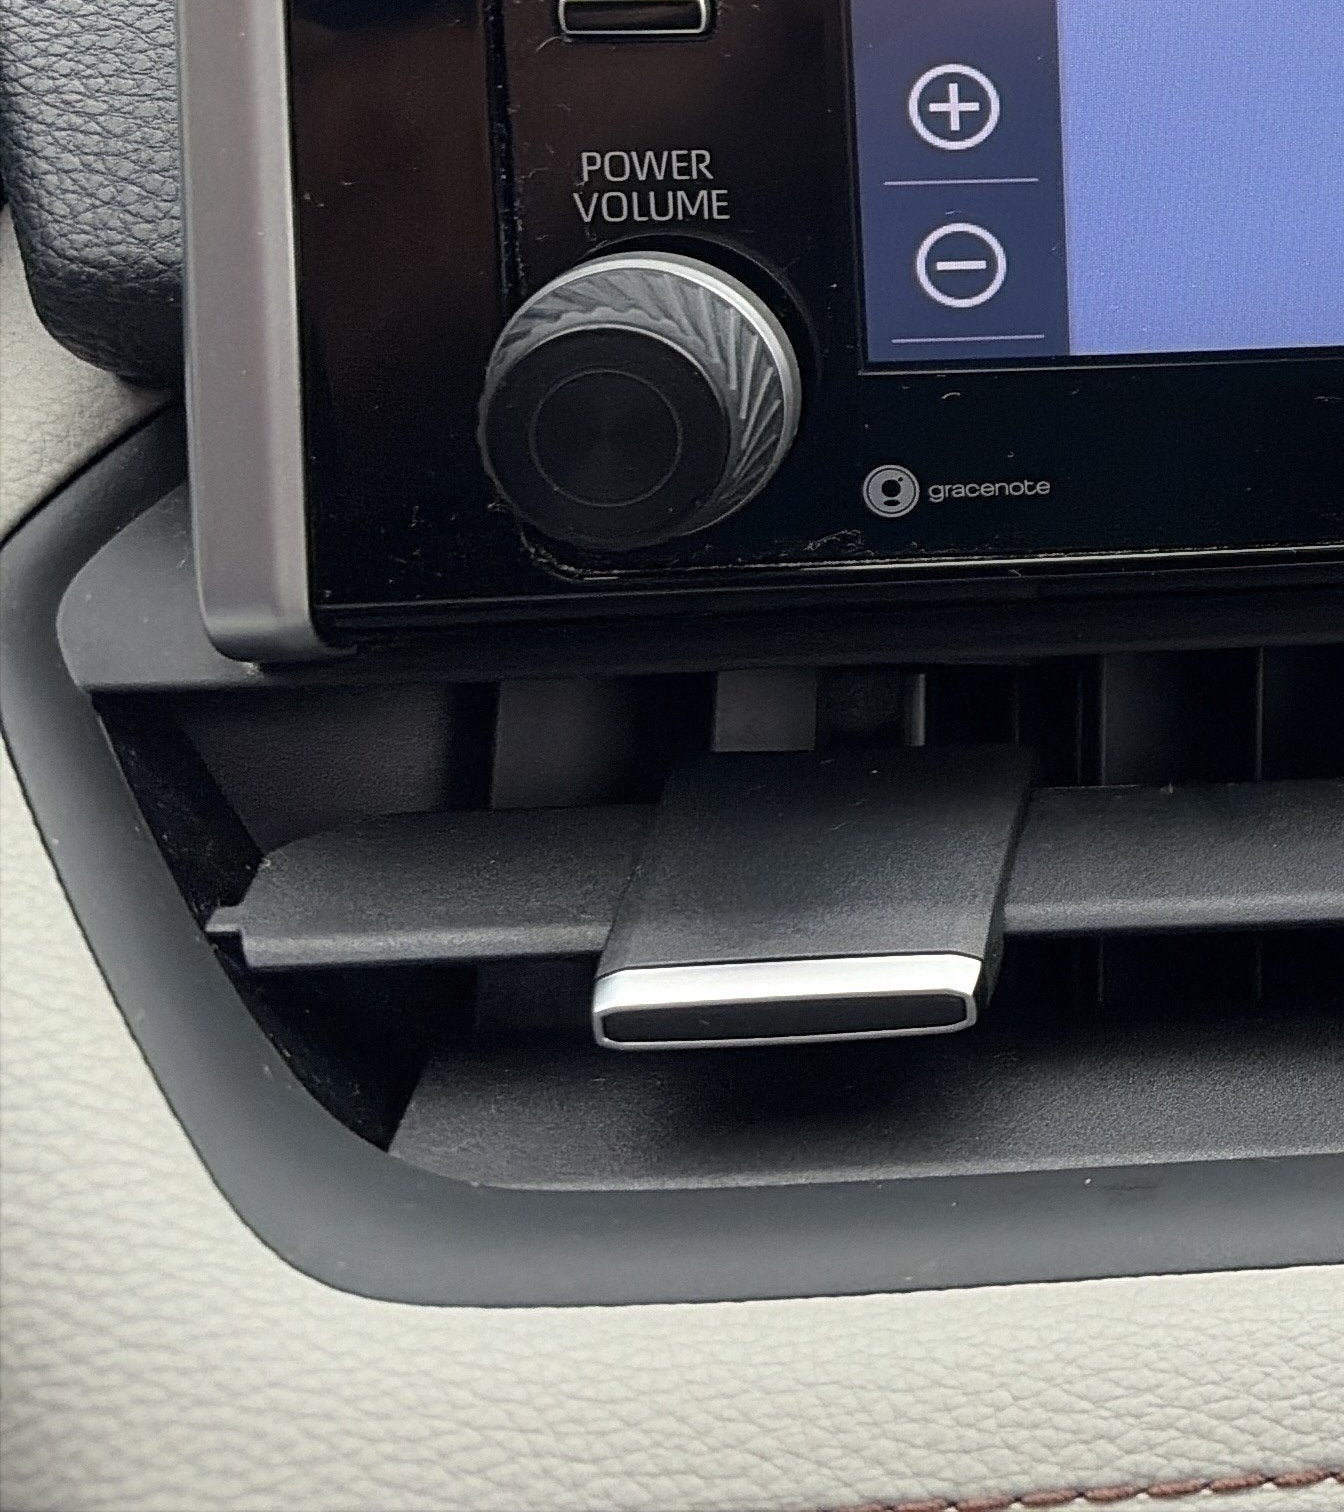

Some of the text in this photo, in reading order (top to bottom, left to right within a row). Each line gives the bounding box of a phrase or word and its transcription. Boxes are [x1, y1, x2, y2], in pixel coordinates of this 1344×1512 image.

[580, 150, 713, 183] POWER
[572, 189, 731, 223] VOLUME
[928, 478, 1052, 502] gracenote
